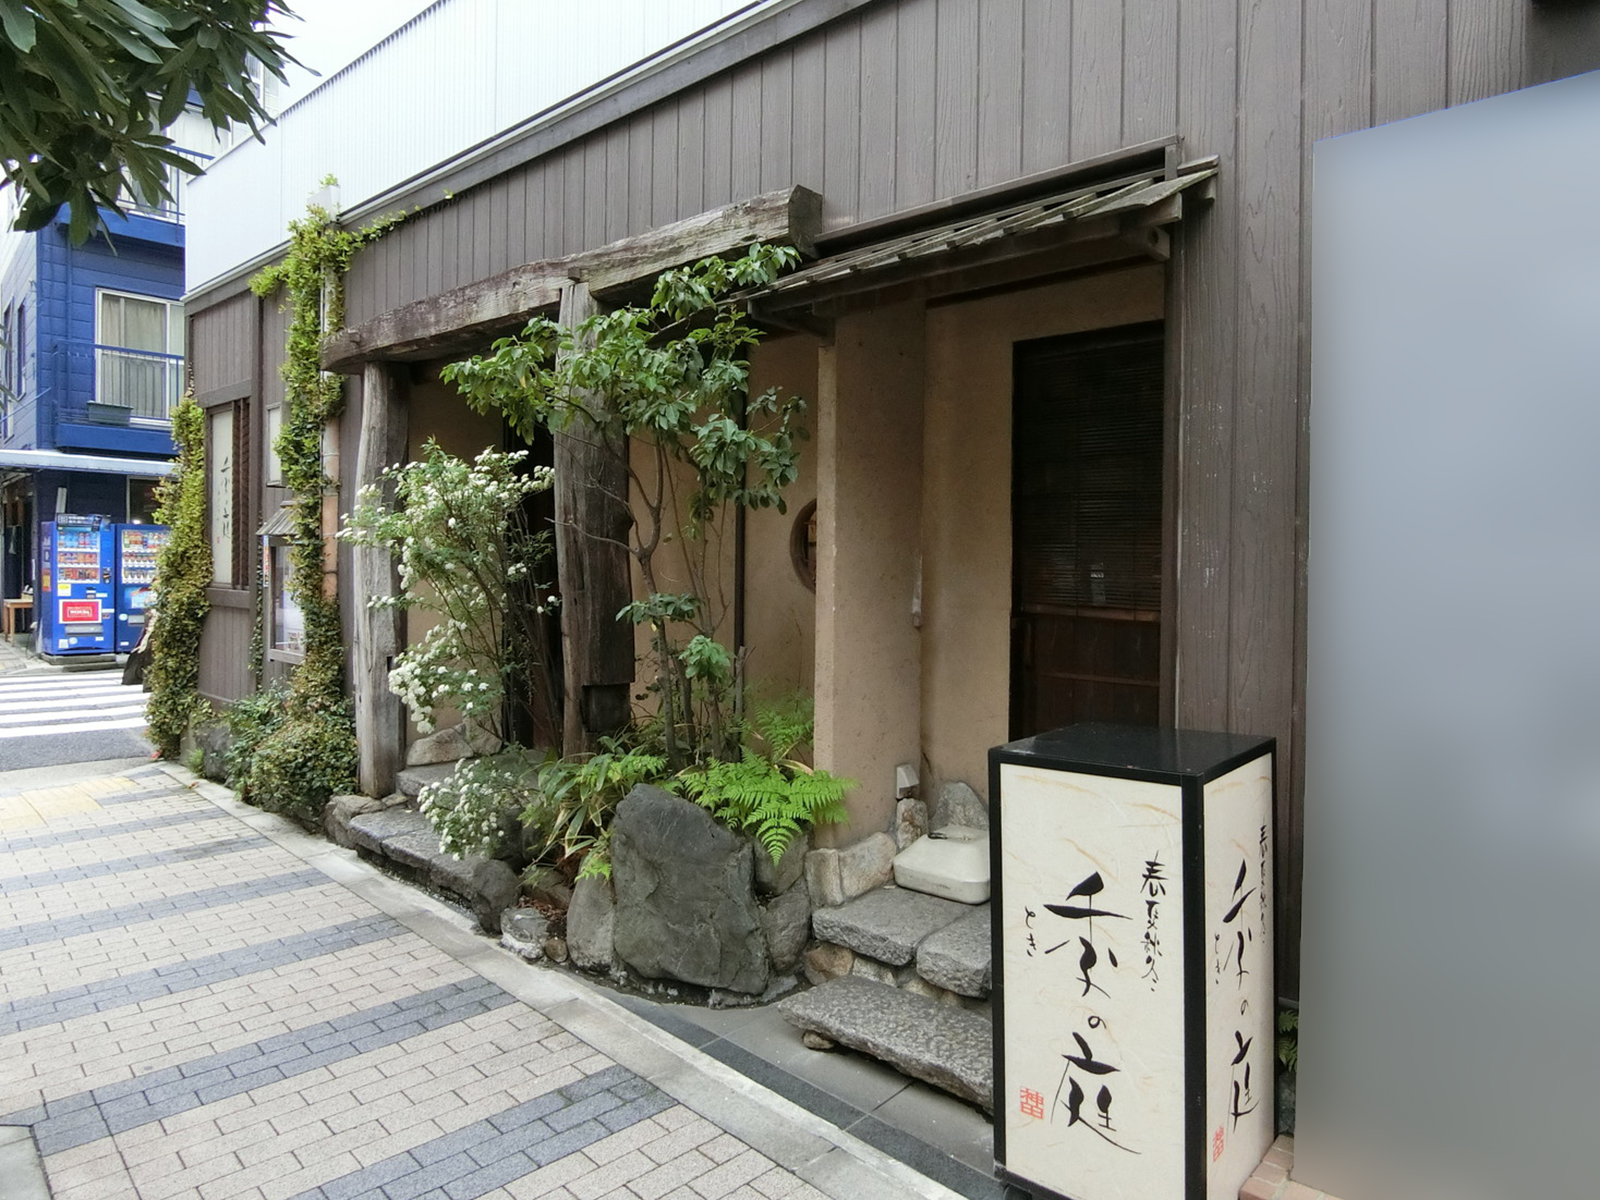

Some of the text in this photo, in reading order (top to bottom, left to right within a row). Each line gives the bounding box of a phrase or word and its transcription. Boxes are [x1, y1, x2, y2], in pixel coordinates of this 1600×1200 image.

[1024, 905, 1038, 958] とき
[1043, 870, 1142, 1155] 季の庭
[1140, 850, 1169, 992] 春夏秋冬
[1222, 857, 1262, 1135] 季の庭
